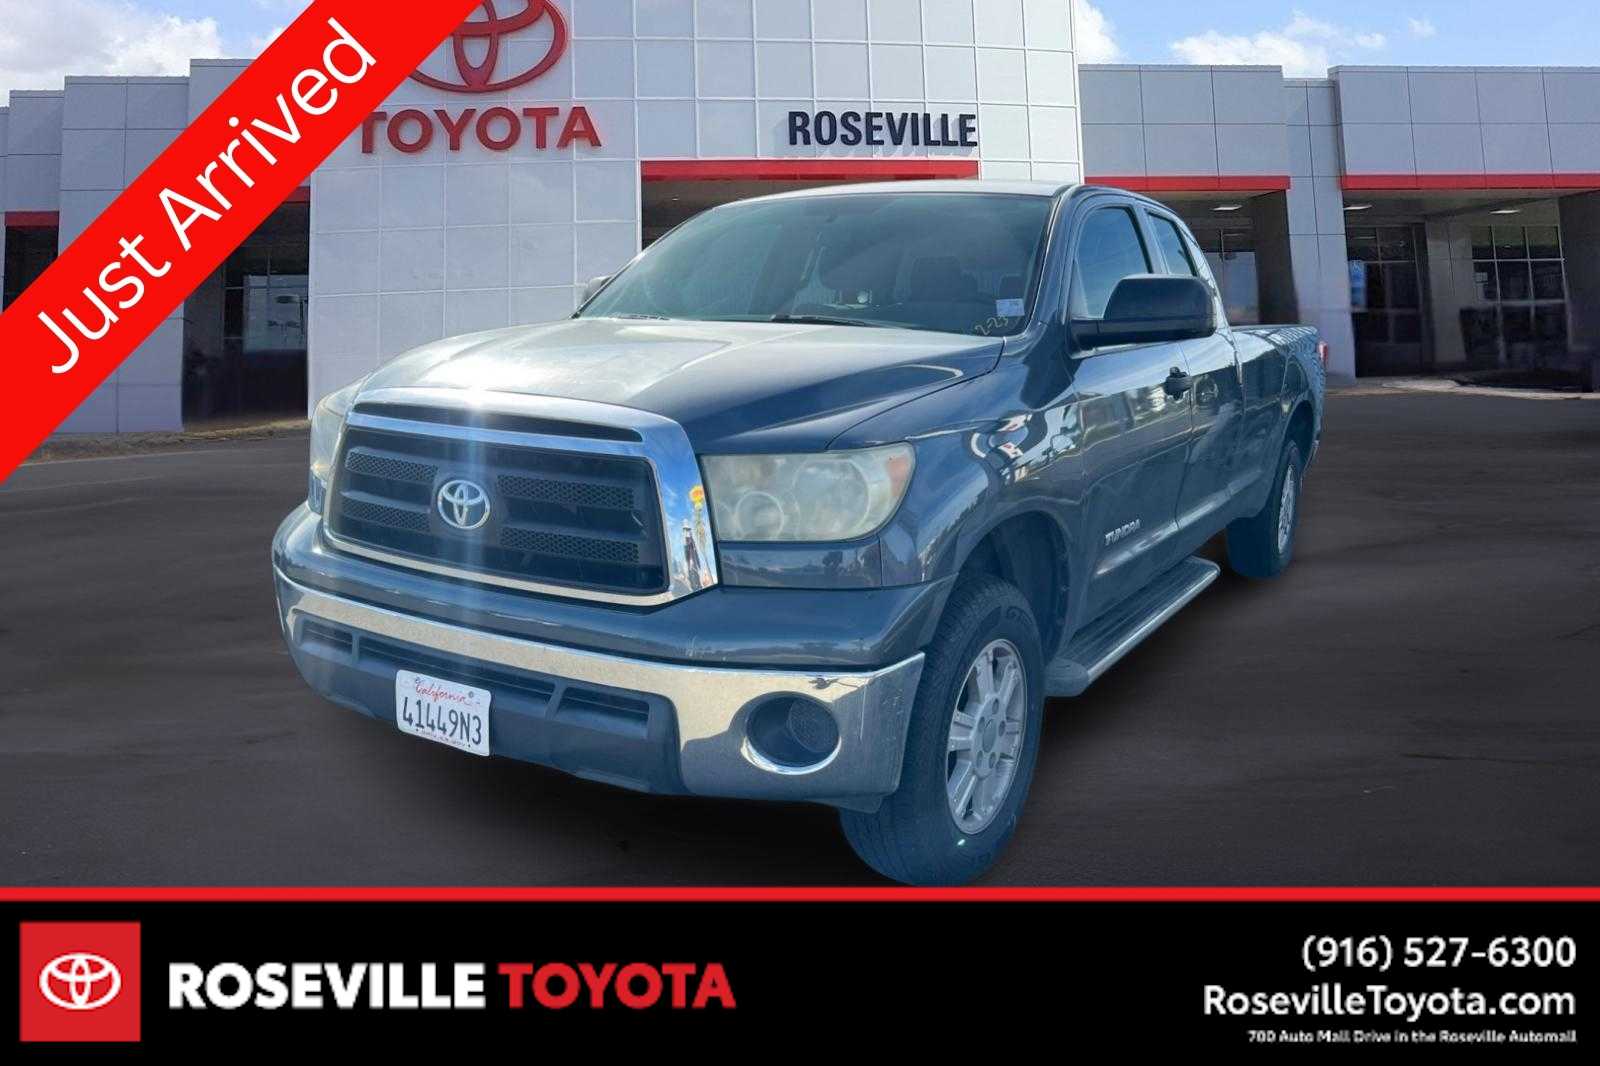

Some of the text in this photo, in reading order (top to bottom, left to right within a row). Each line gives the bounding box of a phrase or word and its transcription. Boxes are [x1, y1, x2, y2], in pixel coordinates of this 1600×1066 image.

[360, 107, 602, 154] TOYOTA
[788, 110, 979, 147] ROSEVILLE
[415, 682, 467, 703] California
[402, 696, 482, 745] 41449N3
